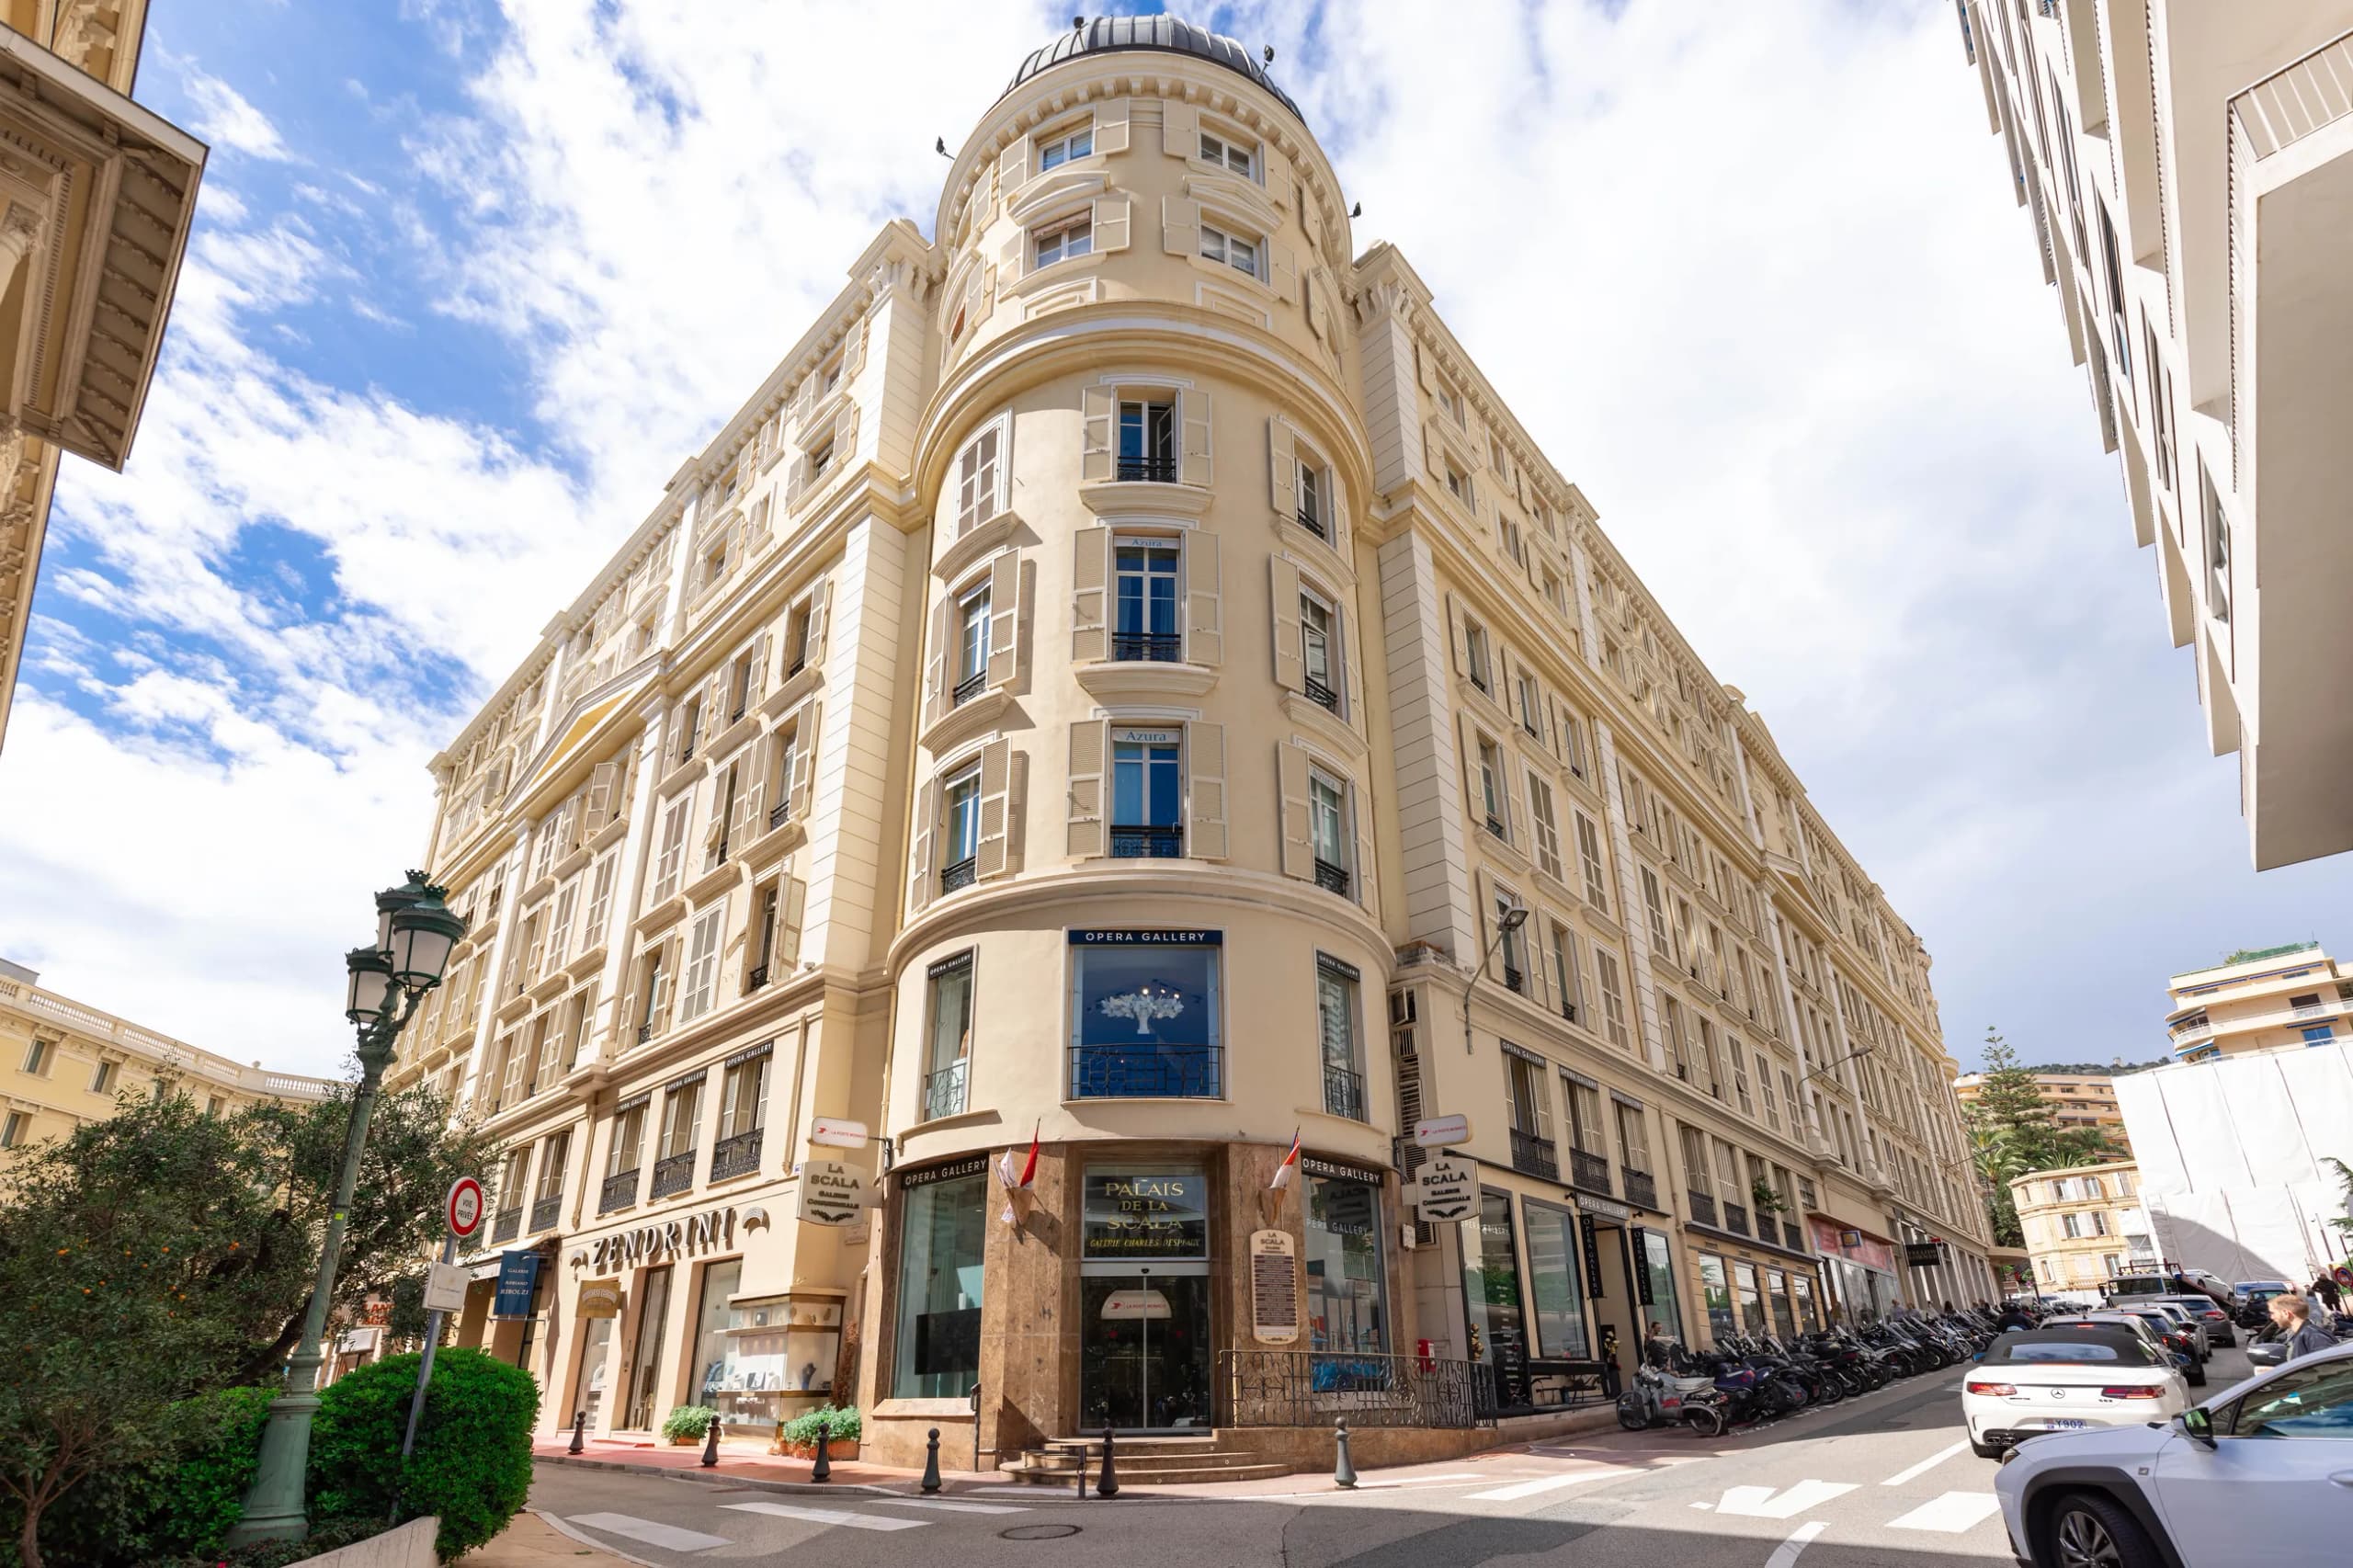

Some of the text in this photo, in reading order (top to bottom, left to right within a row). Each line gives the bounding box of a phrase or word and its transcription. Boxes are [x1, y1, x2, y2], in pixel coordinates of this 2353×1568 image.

[1131, 539, 1162, 547] Azura
[1126, 732, 1166, 741] Azura
[1086, 932, 1205, 941] OPERA GALLERY
[726, 1043, 772, 1067] OPERA GALLERY
[1502, 1041, 1545, 1065] OPERA GALLERY
[666, 1070, 707, 1091] OPERA GALLERY
[828, 1164, 845, 1175] LA
[905, 1160, 986, 1185] OPERA GALLERY
[1302, 1158, 1380, 1183] OPERA GALLERY
[1436, 1163, 1450, 1171] LA
[811, 1175, 860, 1189] SCALA
[1422, 1172, 1468, 1186] SCALA
[1105, 1183, 1184, 1196] PALAIS
[462, 1199, 472, 1208] VOIE
[1121, 1200, 1168, 1211] DE LA
[1580, 1197, 1627, 1216] OPERA GALLERY
[1107, 1214, 1184, 1230] SCALA
[1332, 1222, 1368, 1235] GALLERY
[591, 1208, 735, 1267] ZENDRINI
[1090, 1238, 1120, 1247] GALERIE
[1124, 1238, 1159, 1247] CHARLES
[2056, 1419, 2084, 1428] Y902
